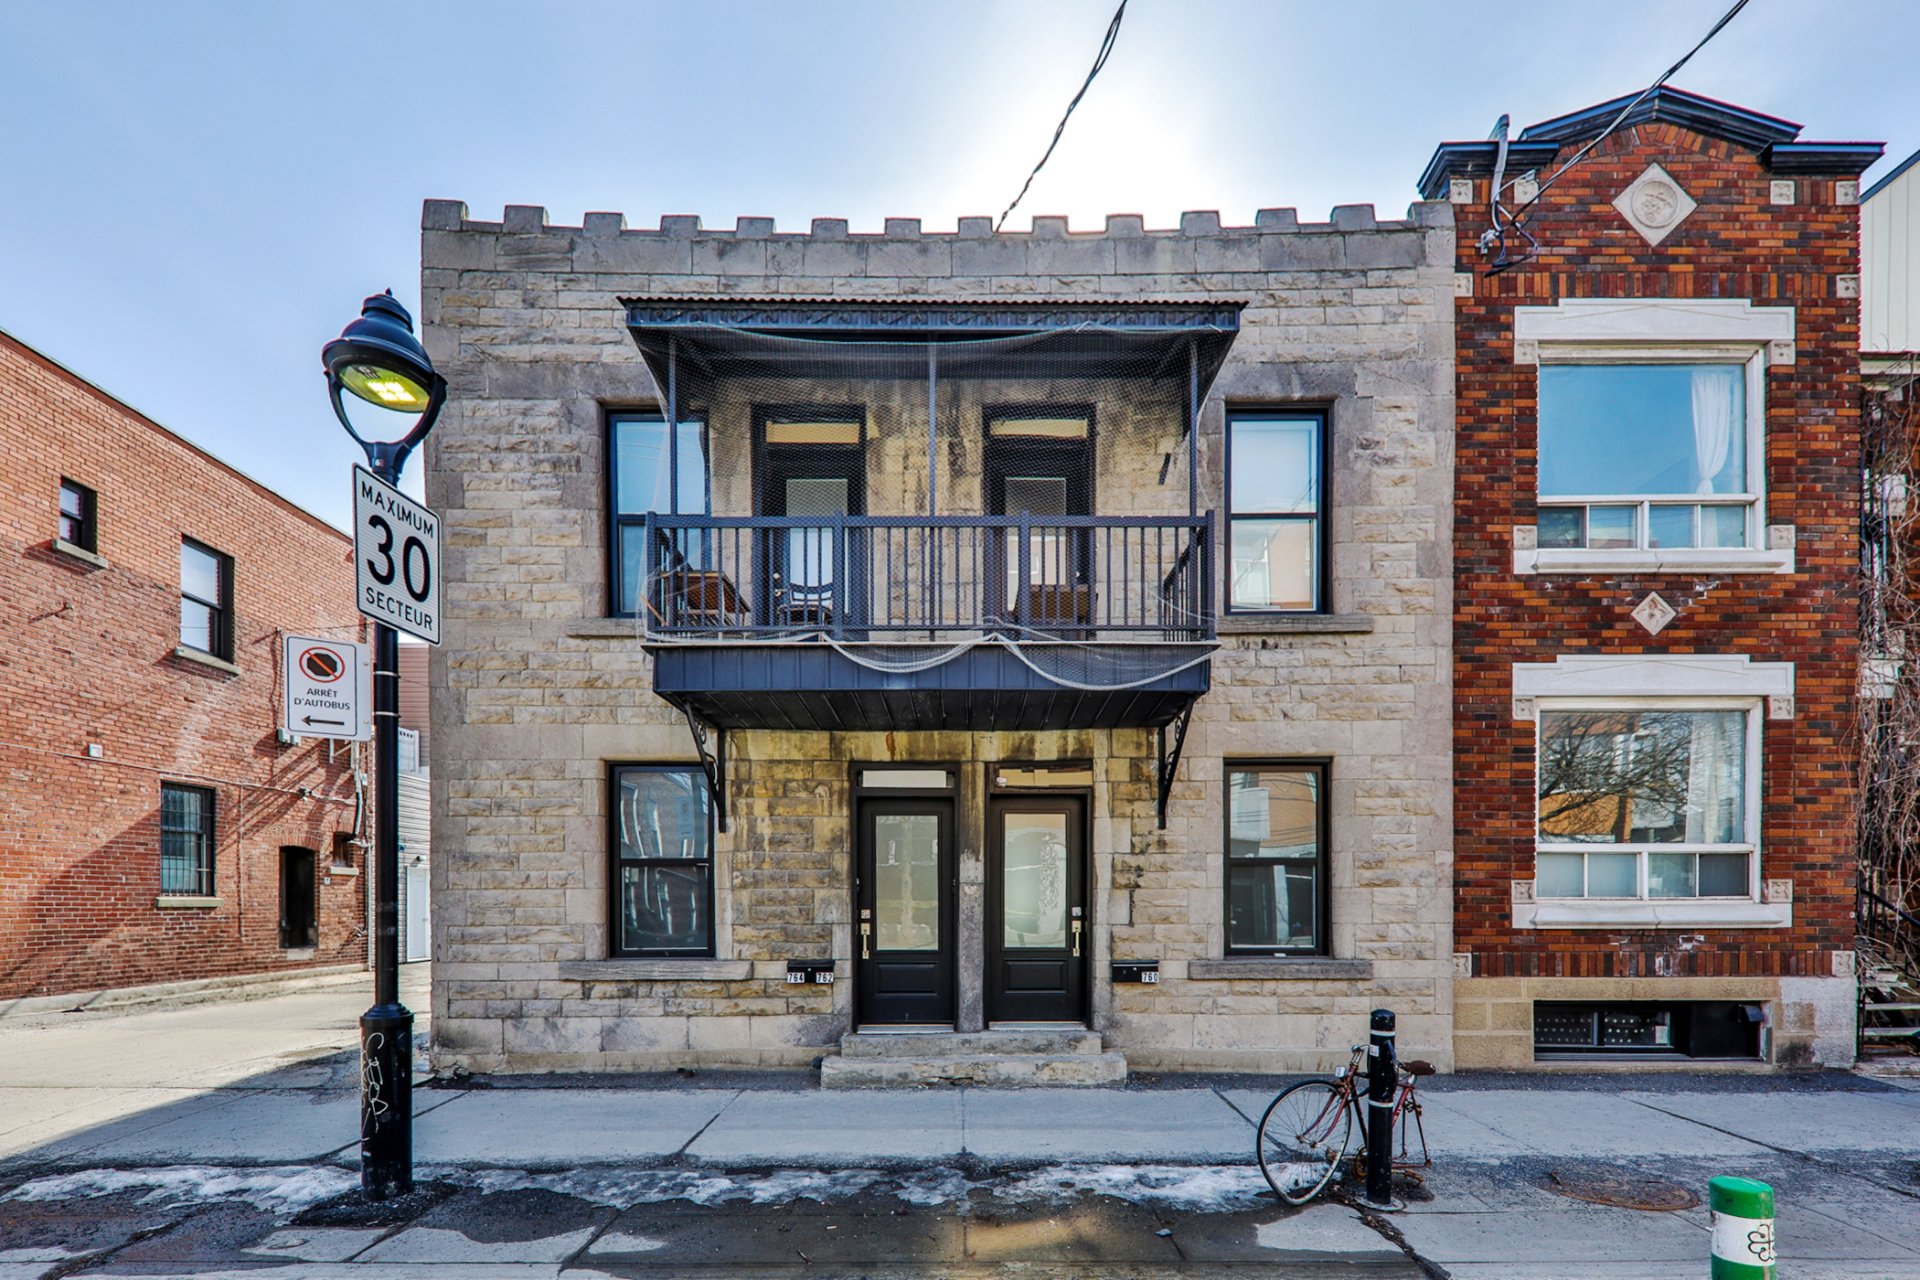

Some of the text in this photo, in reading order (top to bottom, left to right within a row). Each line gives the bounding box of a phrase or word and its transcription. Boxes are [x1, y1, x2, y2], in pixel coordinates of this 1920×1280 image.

[361, 480, 434, 539] MAXIMUM
[366, 514, 432, 603] 30
[365, 586, 433, 631] SECTEUR
[306, 687, 338, 698] ARRÊT
[293, 697, 351, 711] D'AUTOBUS
[788, 973, 803, 982] 764
[817, 973, 832, 982] 762
[1143, 972, 1158, 982] 760
